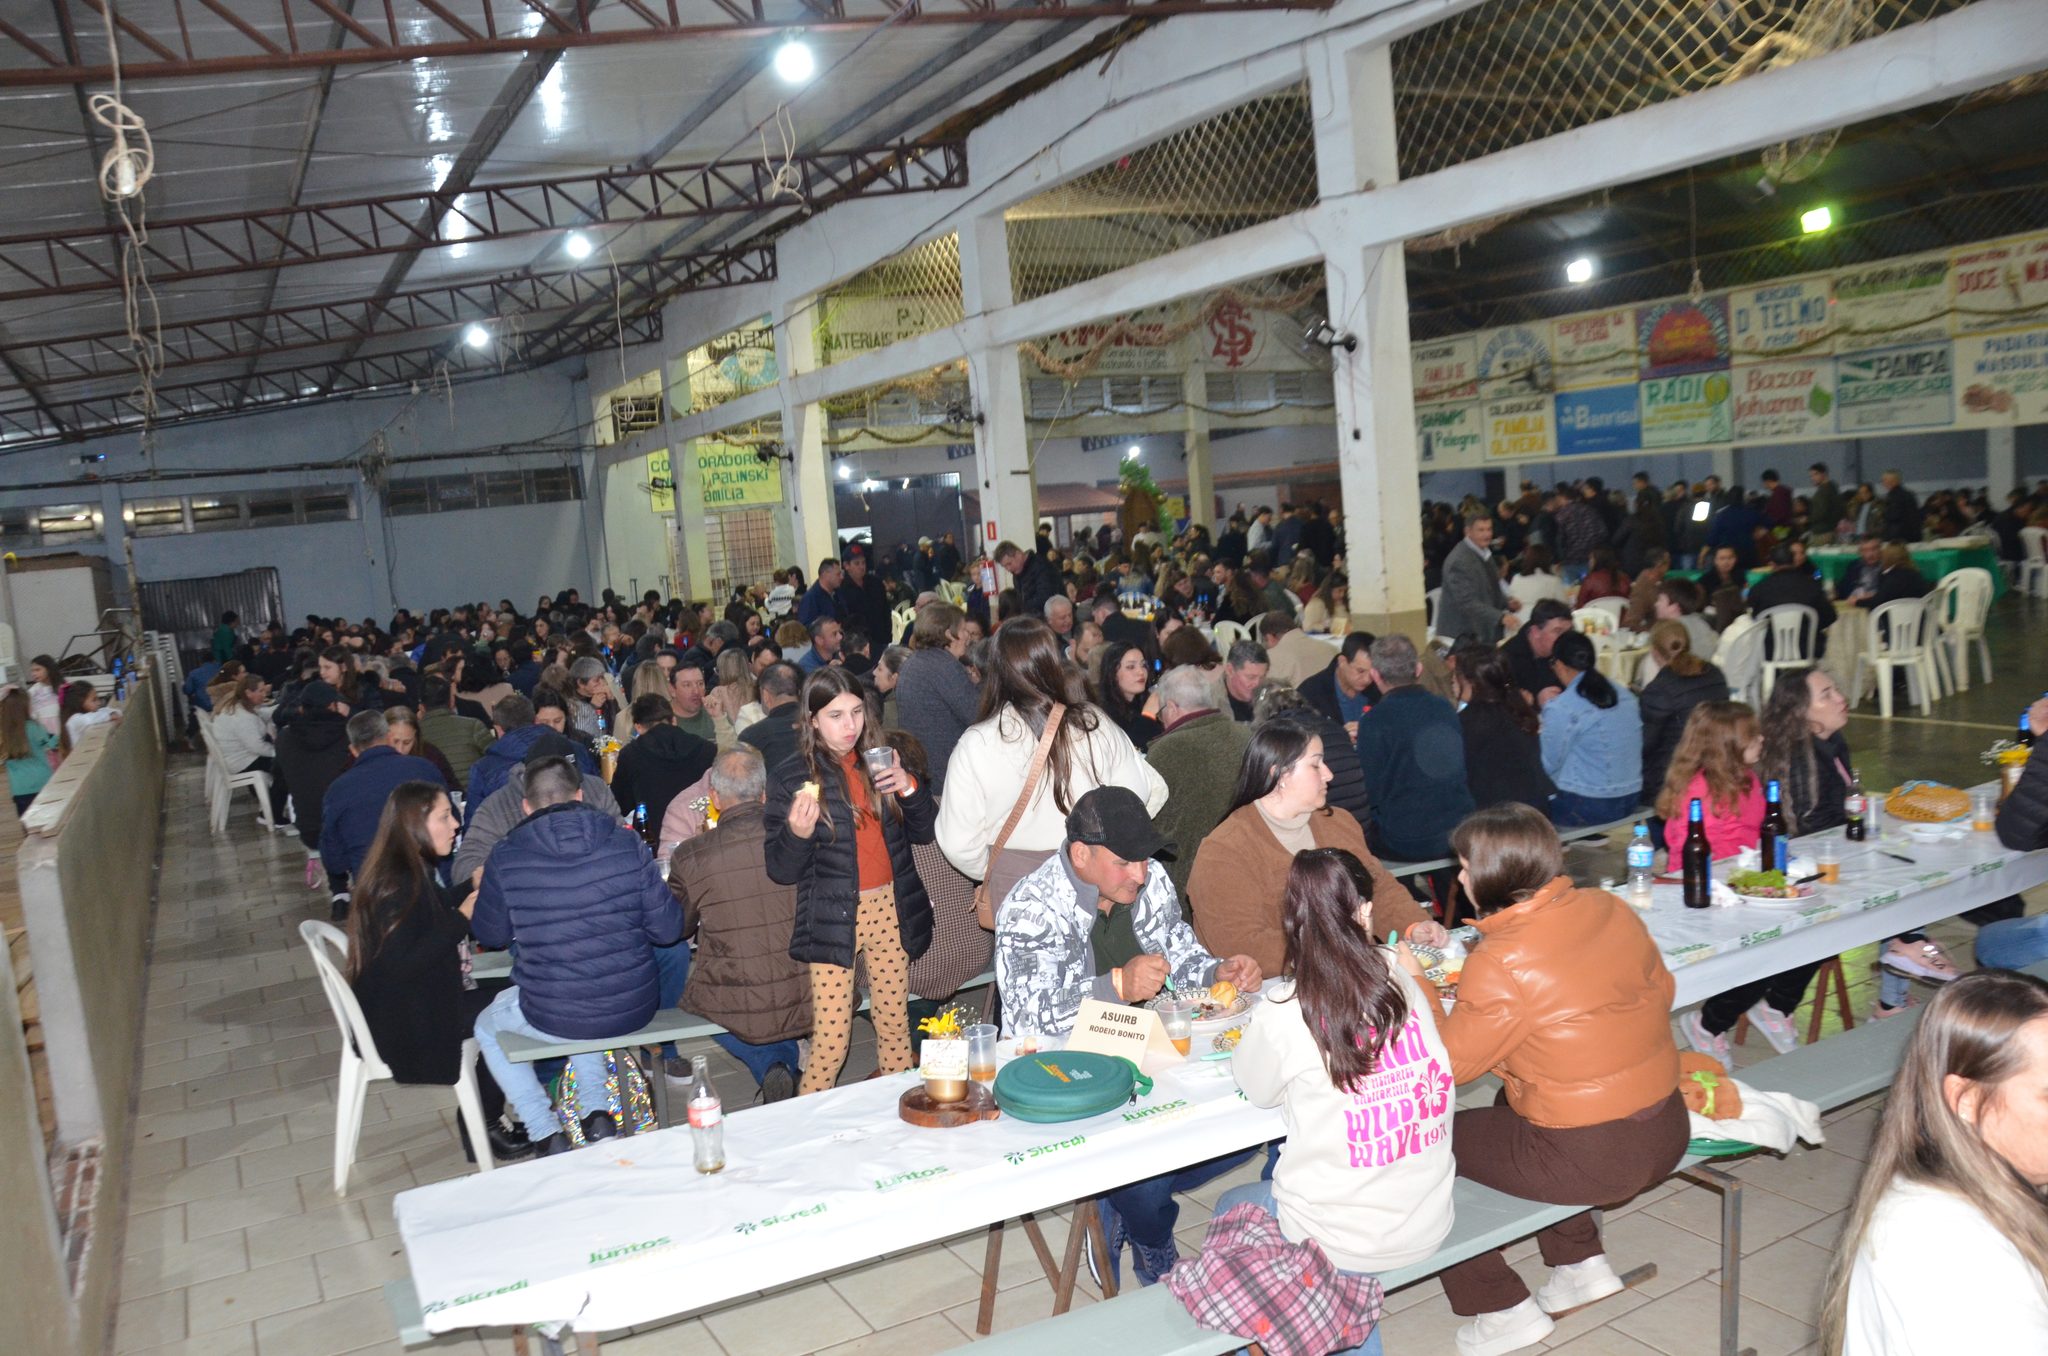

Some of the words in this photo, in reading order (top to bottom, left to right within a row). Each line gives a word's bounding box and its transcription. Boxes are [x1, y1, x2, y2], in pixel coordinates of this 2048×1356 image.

[1760, 295, 1826, 331] TELMO
[711, 329, 775, 350] GREMI
[1873, 349, 1951, 381] PAMPA
[1100, 1011, 1138, 1025] ASUIRB
[1089, 1024, 1116, 1036] RODEIO
[1117, 1030, 1146, 1041] BONITO
[1121, 1098, 1188, 1122] Juntos
[1343, 1098, 1414, 1143] WILD
[1027, 1134, 1087, 1158] Sicredi
[1347, 1122, 1422, 1168] WAVE
[760, 1201, 828, 1228] Sicredi
[588, 1236, 673, 1265] Juntos
[453, 1278, 529, 1306] Sicredi
